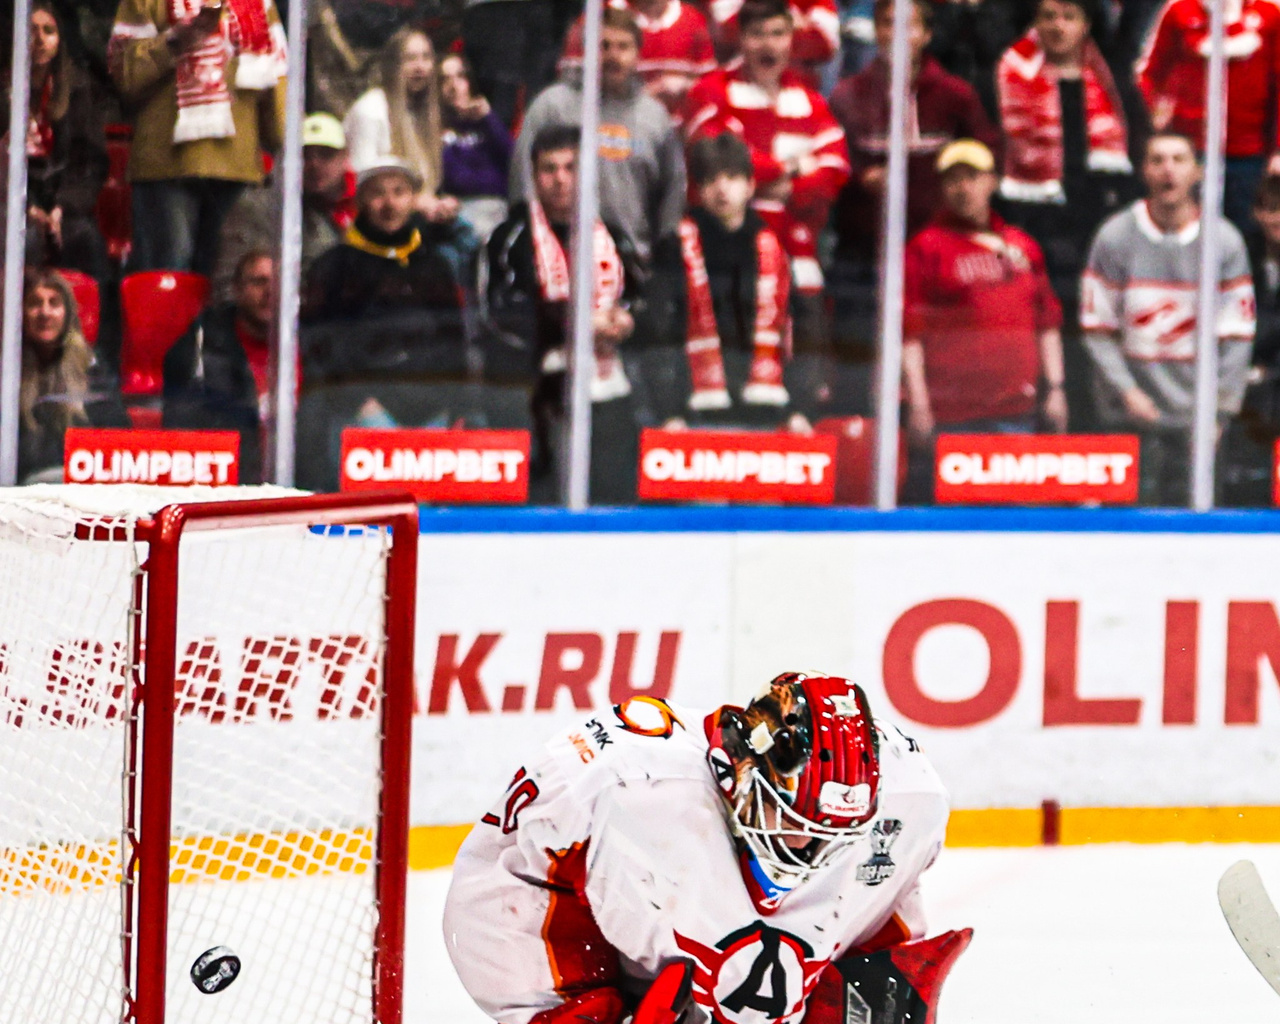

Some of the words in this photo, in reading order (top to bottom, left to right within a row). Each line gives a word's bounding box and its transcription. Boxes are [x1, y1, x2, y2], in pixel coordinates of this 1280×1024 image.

[68, 449, 235, 483] OLIMPBET
[344, 448, 525, 483] OLIMPBET
[643, 448, 830, 484] OLIMPBET
[939, 452, 1134, 485] OLIMPBET
